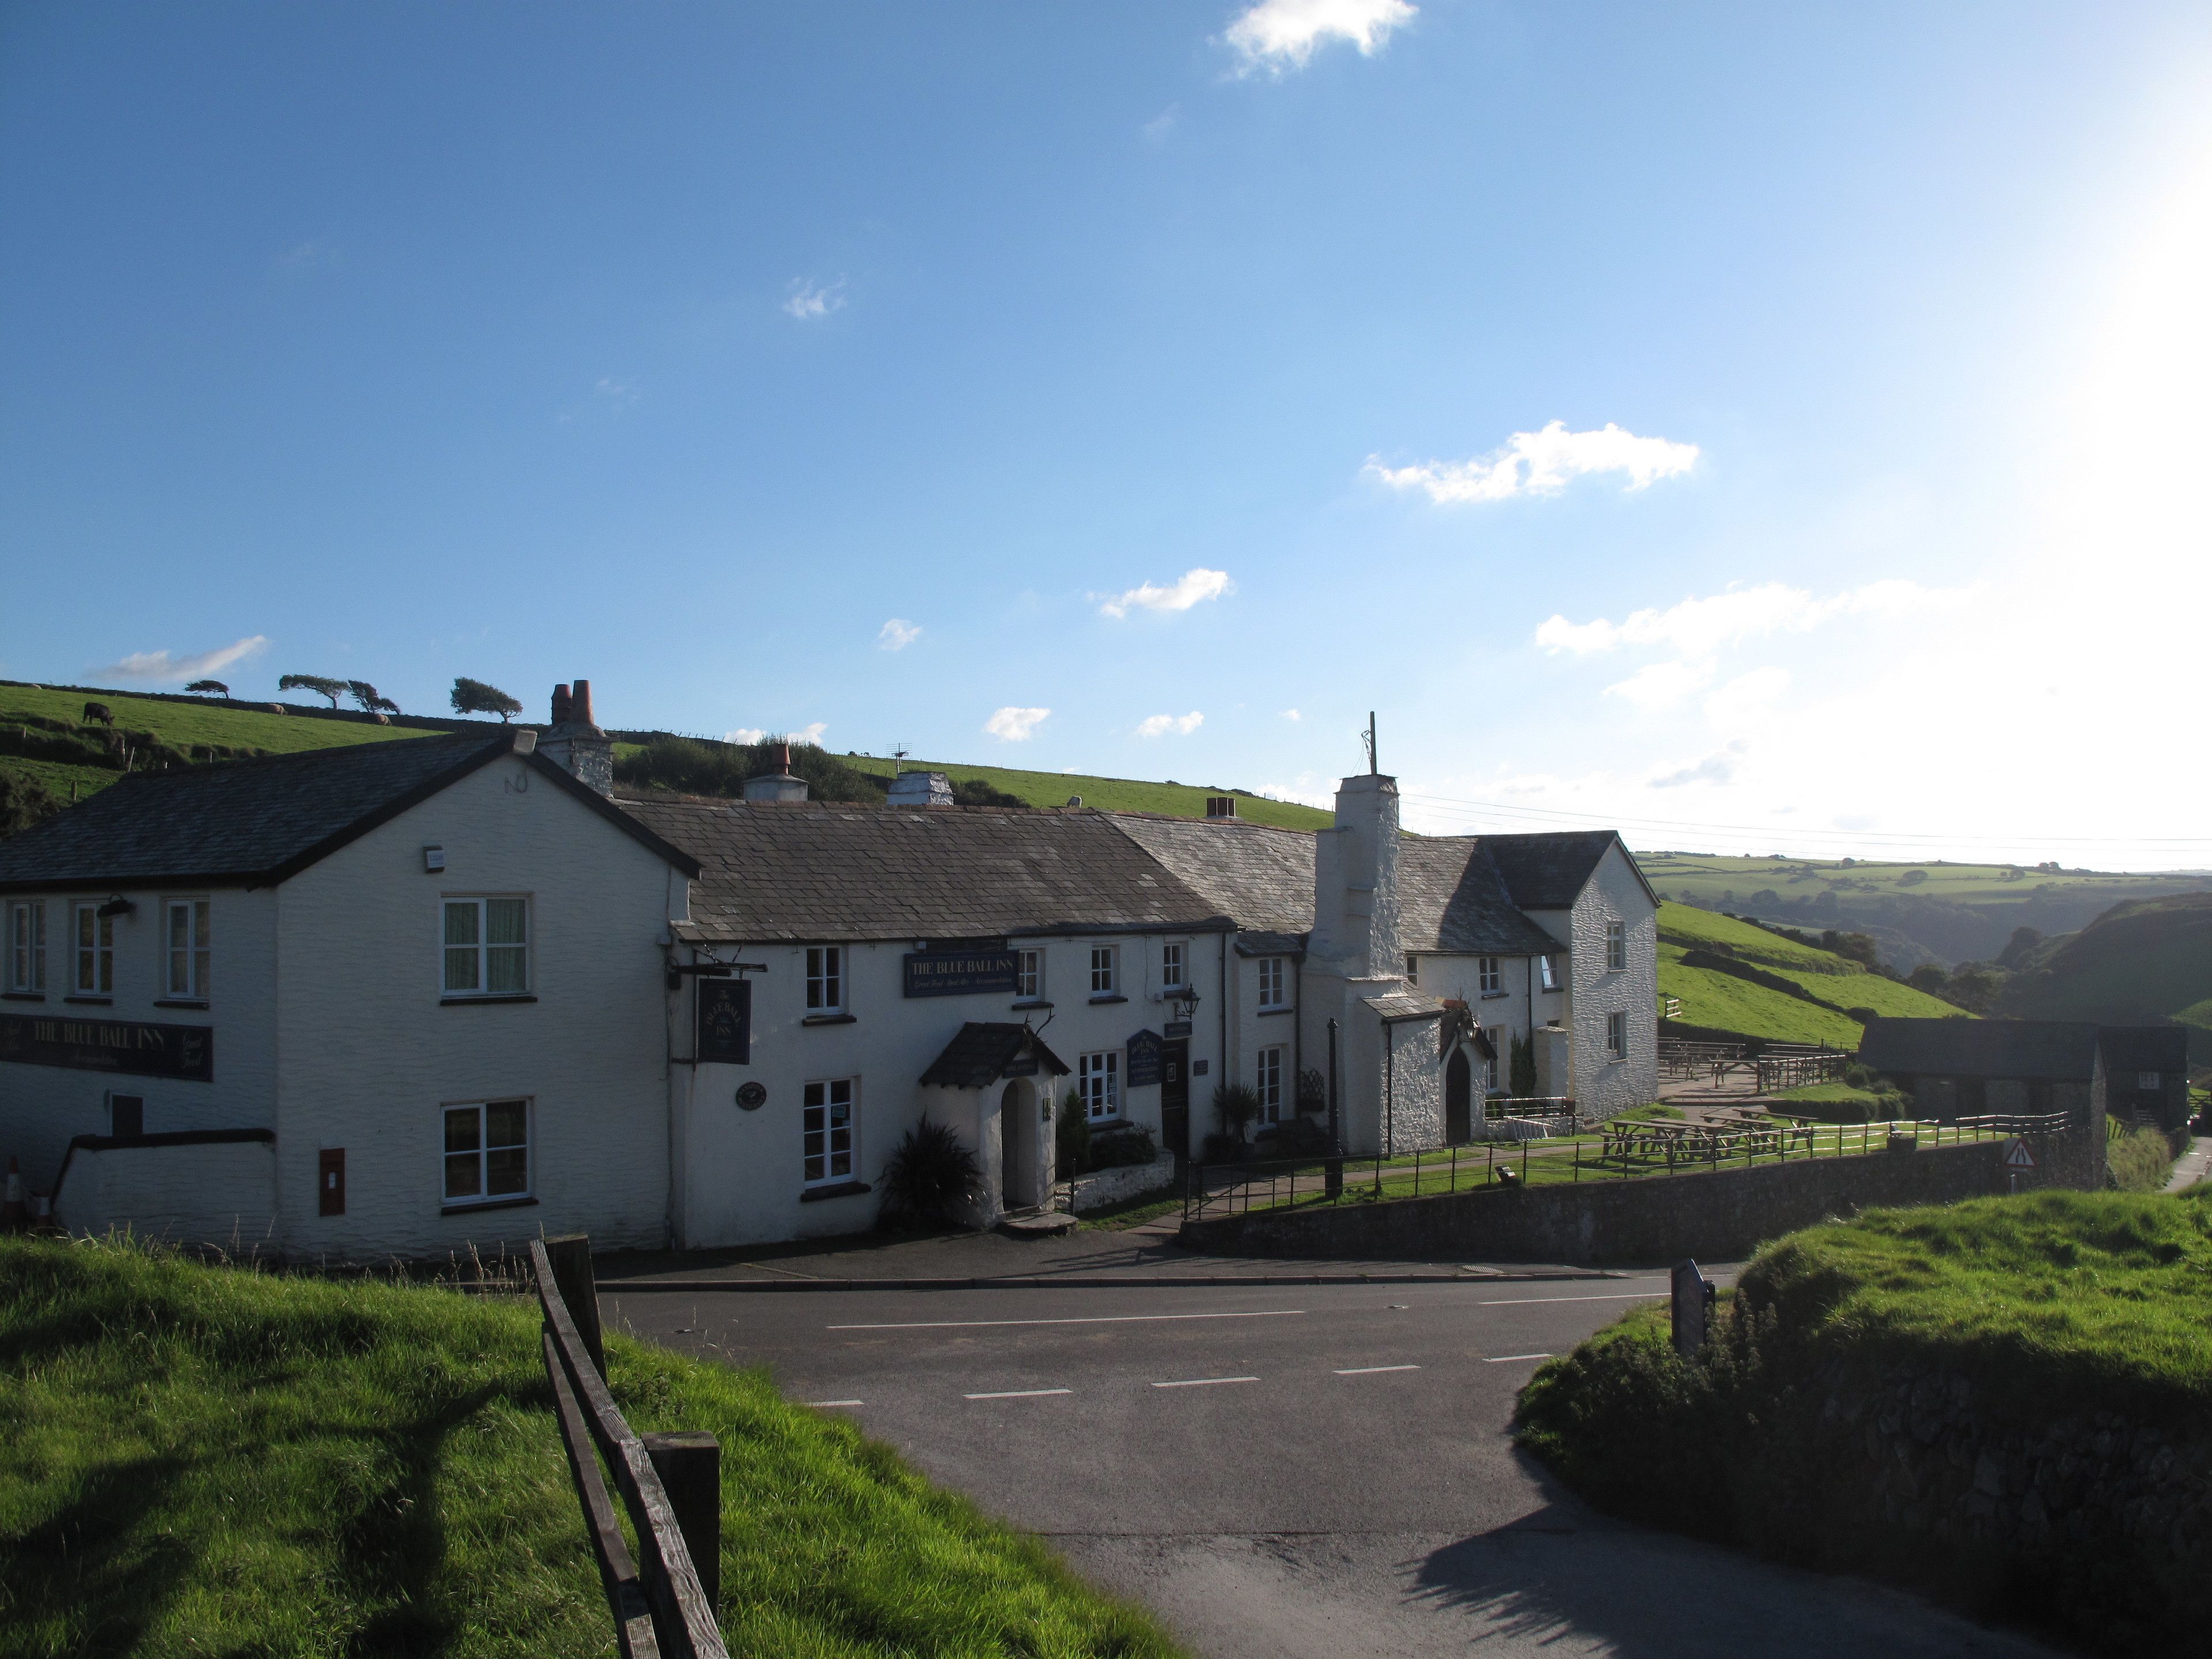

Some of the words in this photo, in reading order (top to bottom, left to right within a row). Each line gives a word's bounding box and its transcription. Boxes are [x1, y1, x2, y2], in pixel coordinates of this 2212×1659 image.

[912, 962, 933, 975] THE
[937, 961, 964, 974] BLUE
[967, 960, 991, 973] BALL
[995, 959, 1013, 972] INN
[719, 990, 729, 1000] The
[706, 1001, 724, 1026] BLUE
[724, 1001, 742, 1028] BALL
[34, 1021, 58, 1042] THE
[64, 1022, 94, 1046] BLUE
[100, 1025, 131, 1049] BALL
[138, 1028, 165, 1051] INN
[716, 1025, 731, 1037] INN
[1131, 1041, 1145, 1055] BLUE
[1146, 1040, 1158, 1054] BALL
